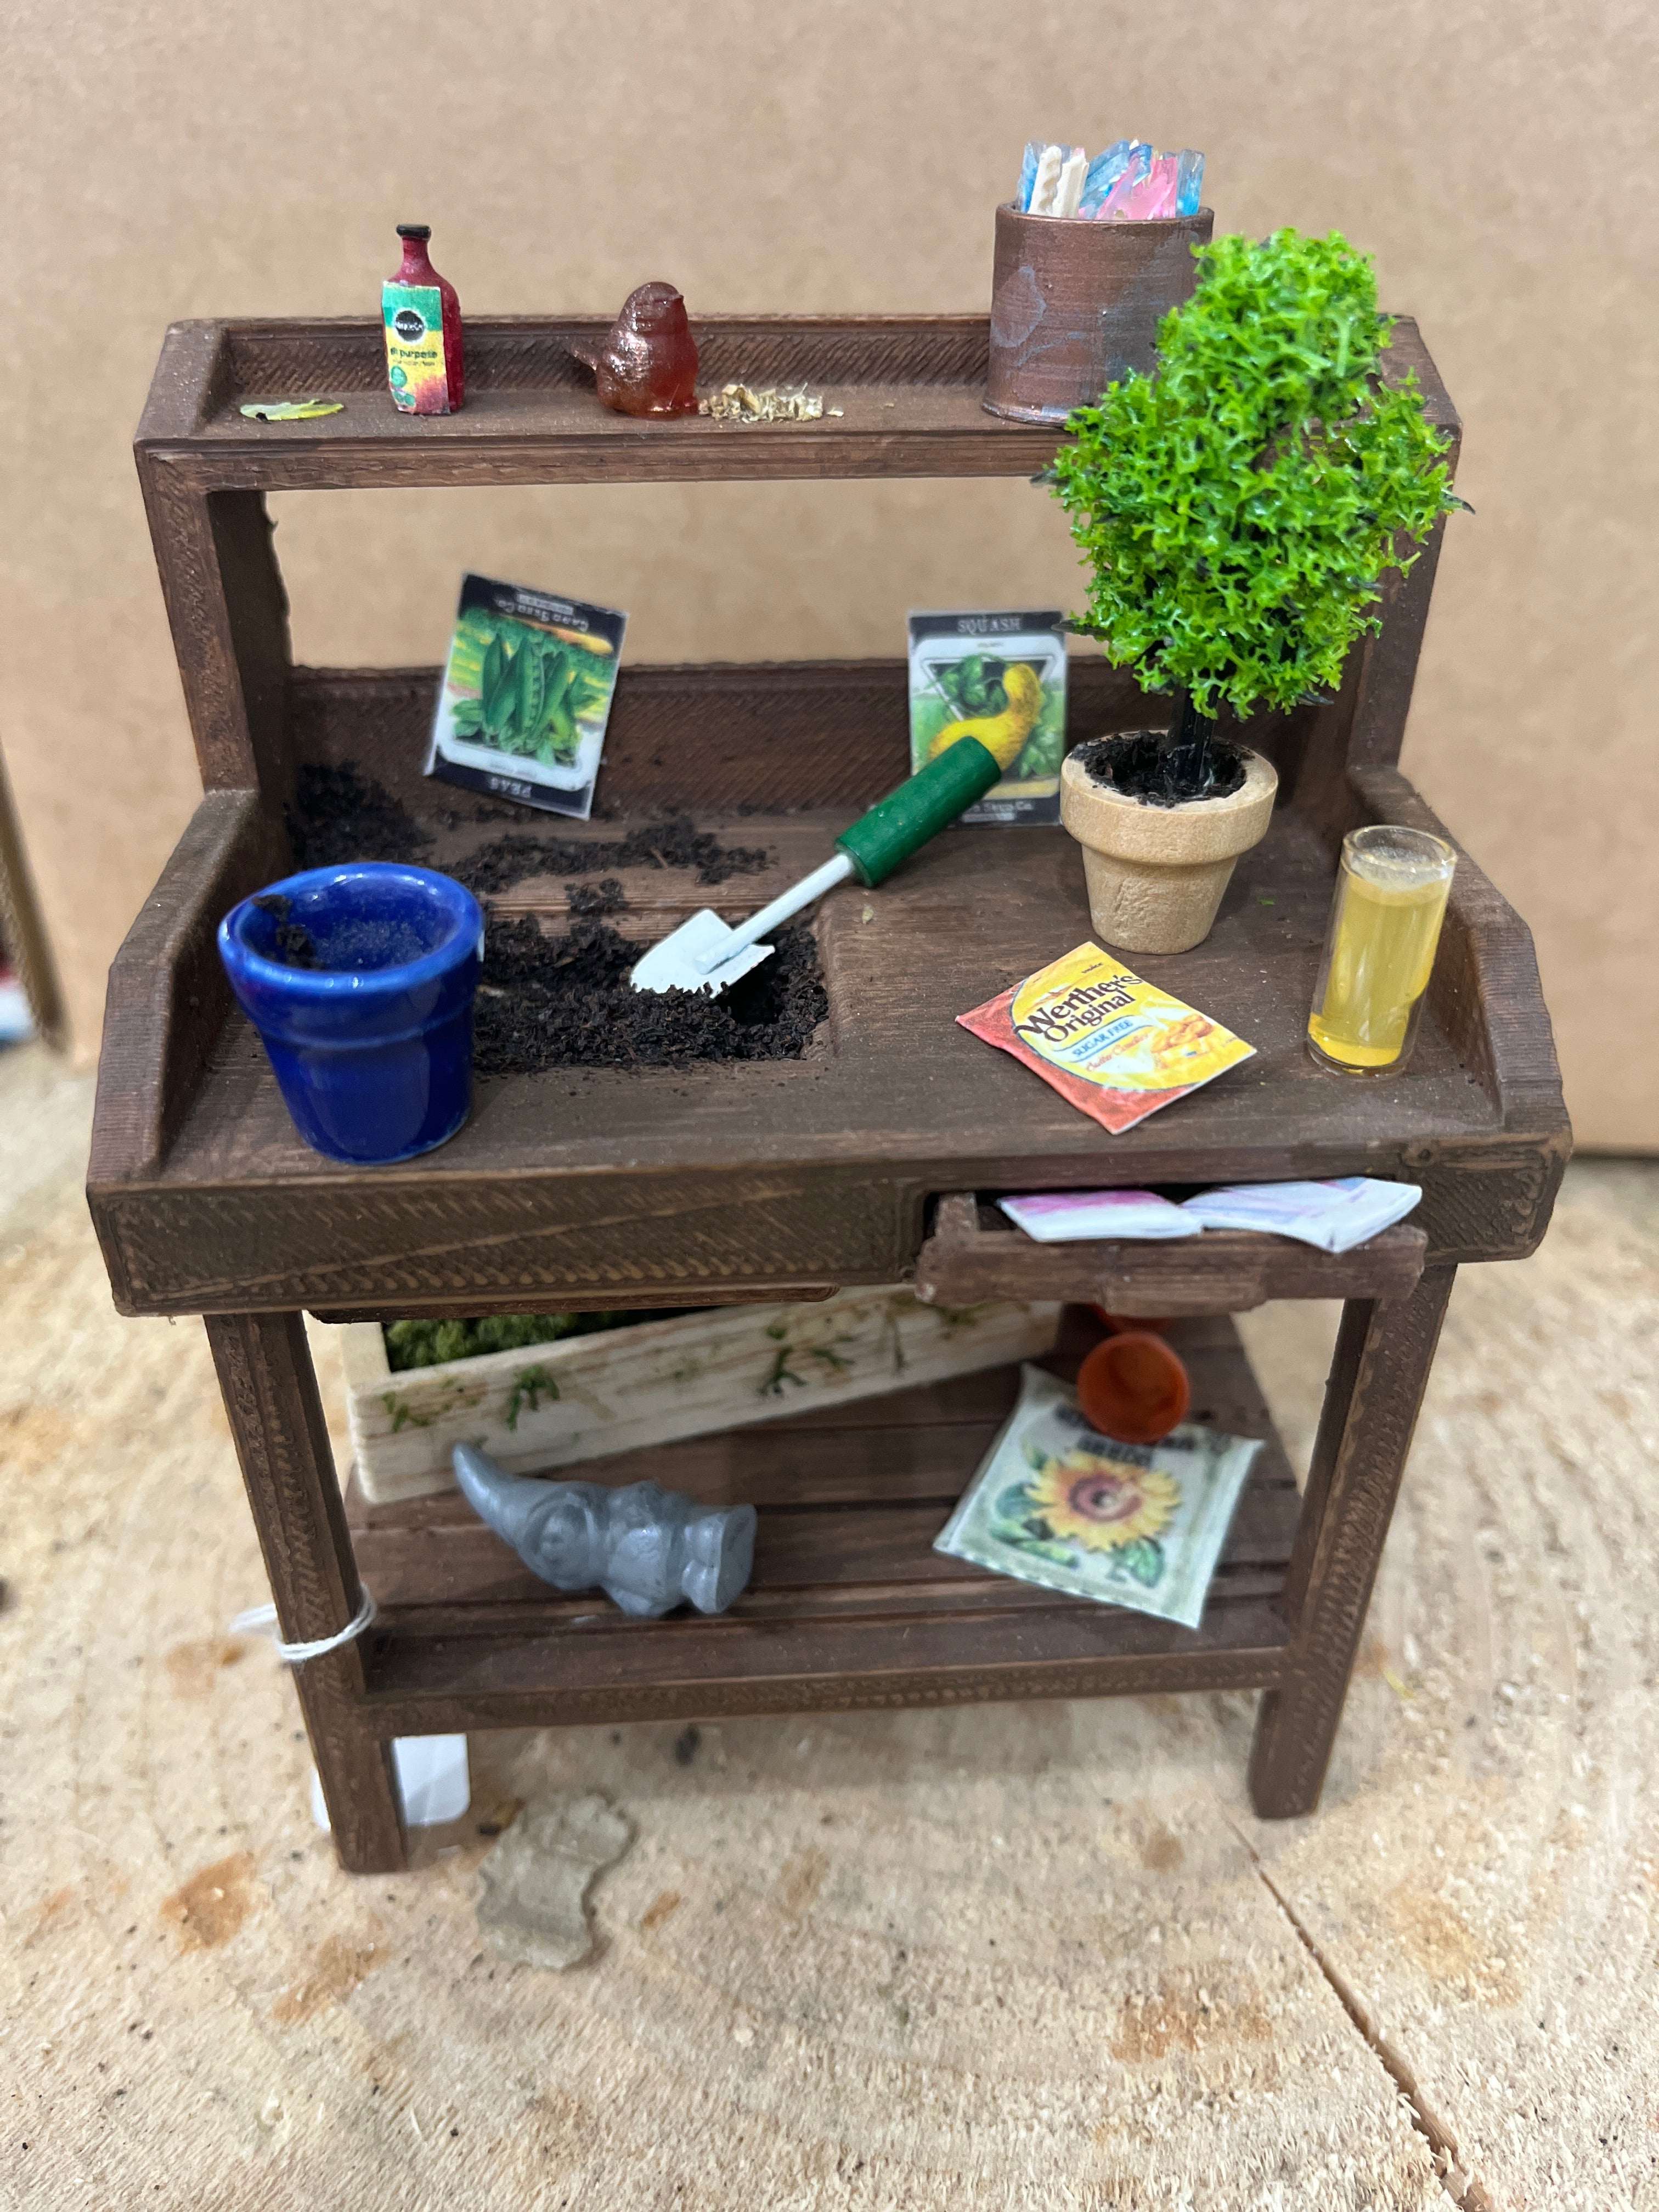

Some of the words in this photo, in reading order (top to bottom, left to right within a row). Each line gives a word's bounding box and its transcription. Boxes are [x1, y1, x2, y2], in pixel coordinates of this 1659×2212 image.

[957, 618, 1022, 635] SQUASH
[490, 777, 532, 798] PEAS
[1013, 975, 1143, 1034] Werther's
[1044, 989, 1136, 1042] Original
[1072, 1033, 1110, 1057] SUGAR
[1107, 1020, 1133, 1036] FREE
